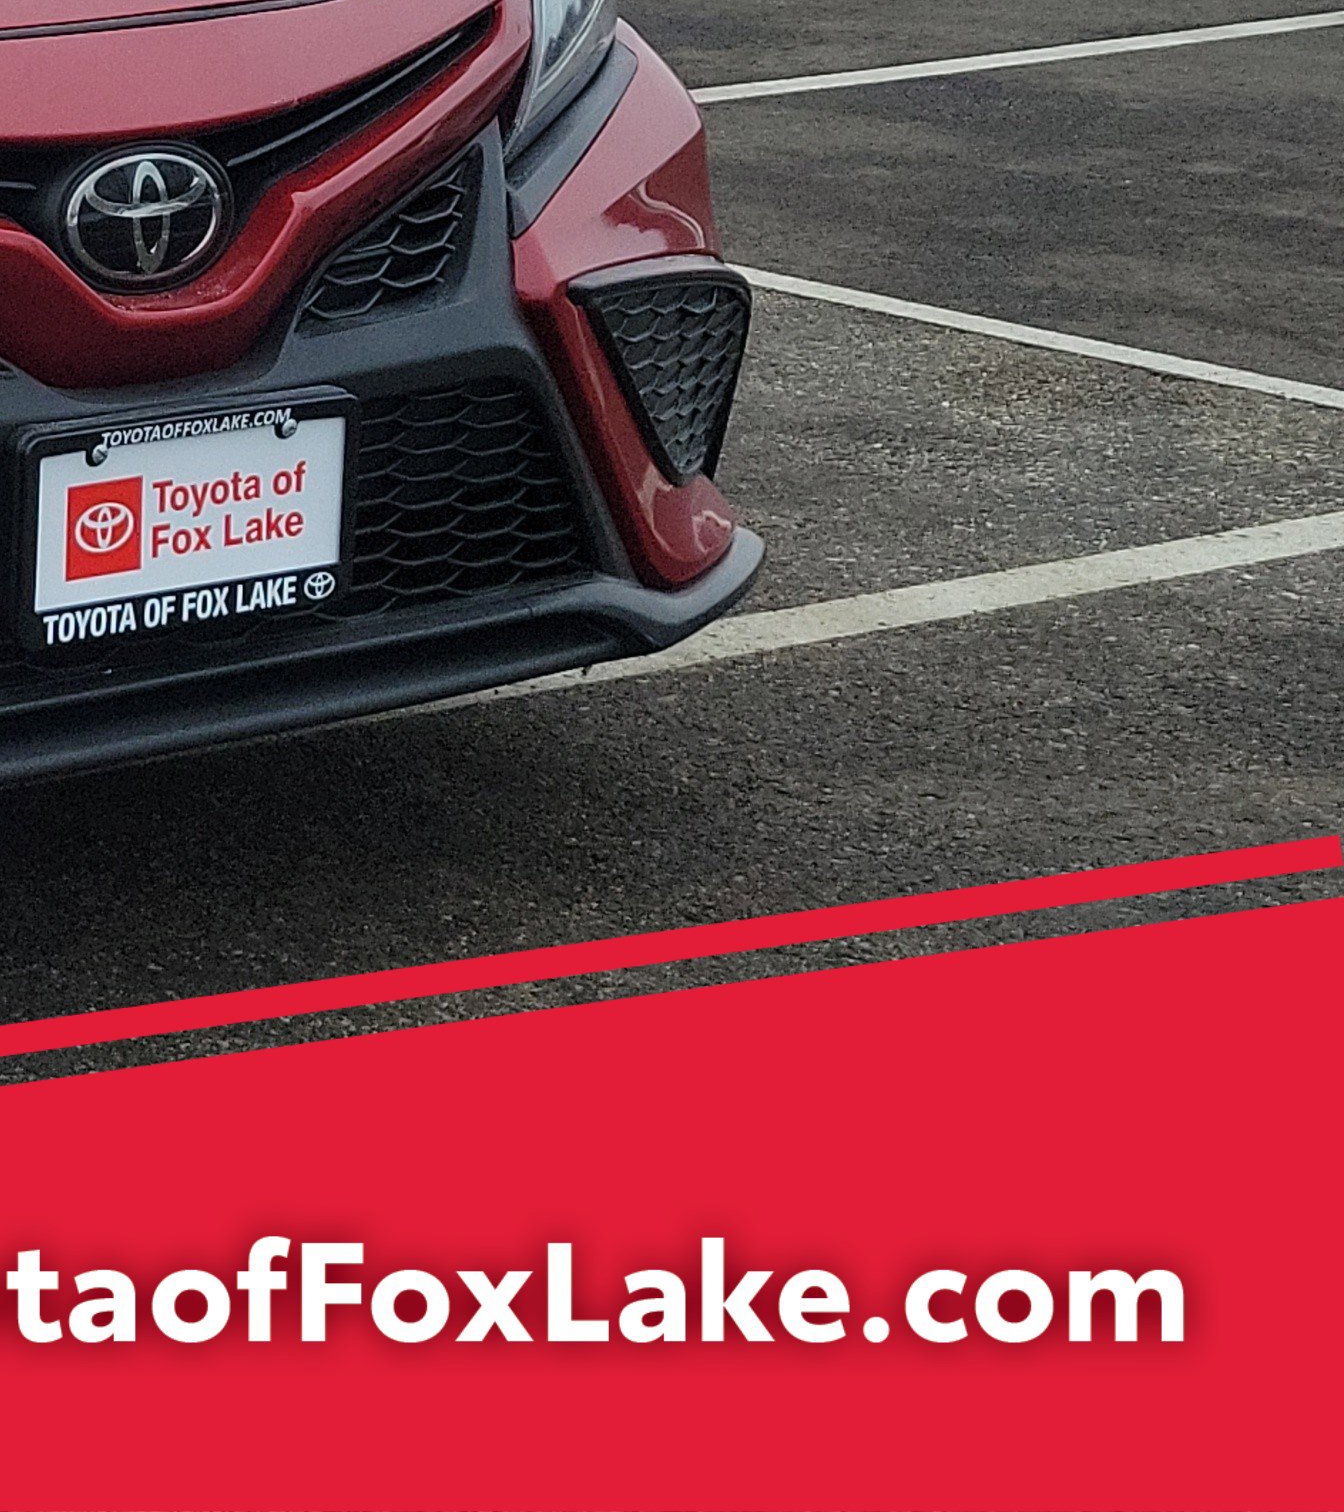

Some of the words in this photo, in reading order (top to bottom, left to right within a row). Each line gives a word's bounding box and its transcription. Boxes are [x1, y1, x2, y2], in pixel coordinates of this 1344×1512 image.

[102, 408, 291, 447] TOYOTAOFFOXLAKE.COM
[152, 471, 261, 516] Toyota
[273, 461, 306, 494] of
[151, 524, 212, 559] Fox
[224, 508, 304, 547] Lake
[43, 602, 136, 645] TOYOTA
[143, 594, 176, 630] OF
[181, 585, 229, 622] FOX
[236, 576, 296, 613] LAKE
